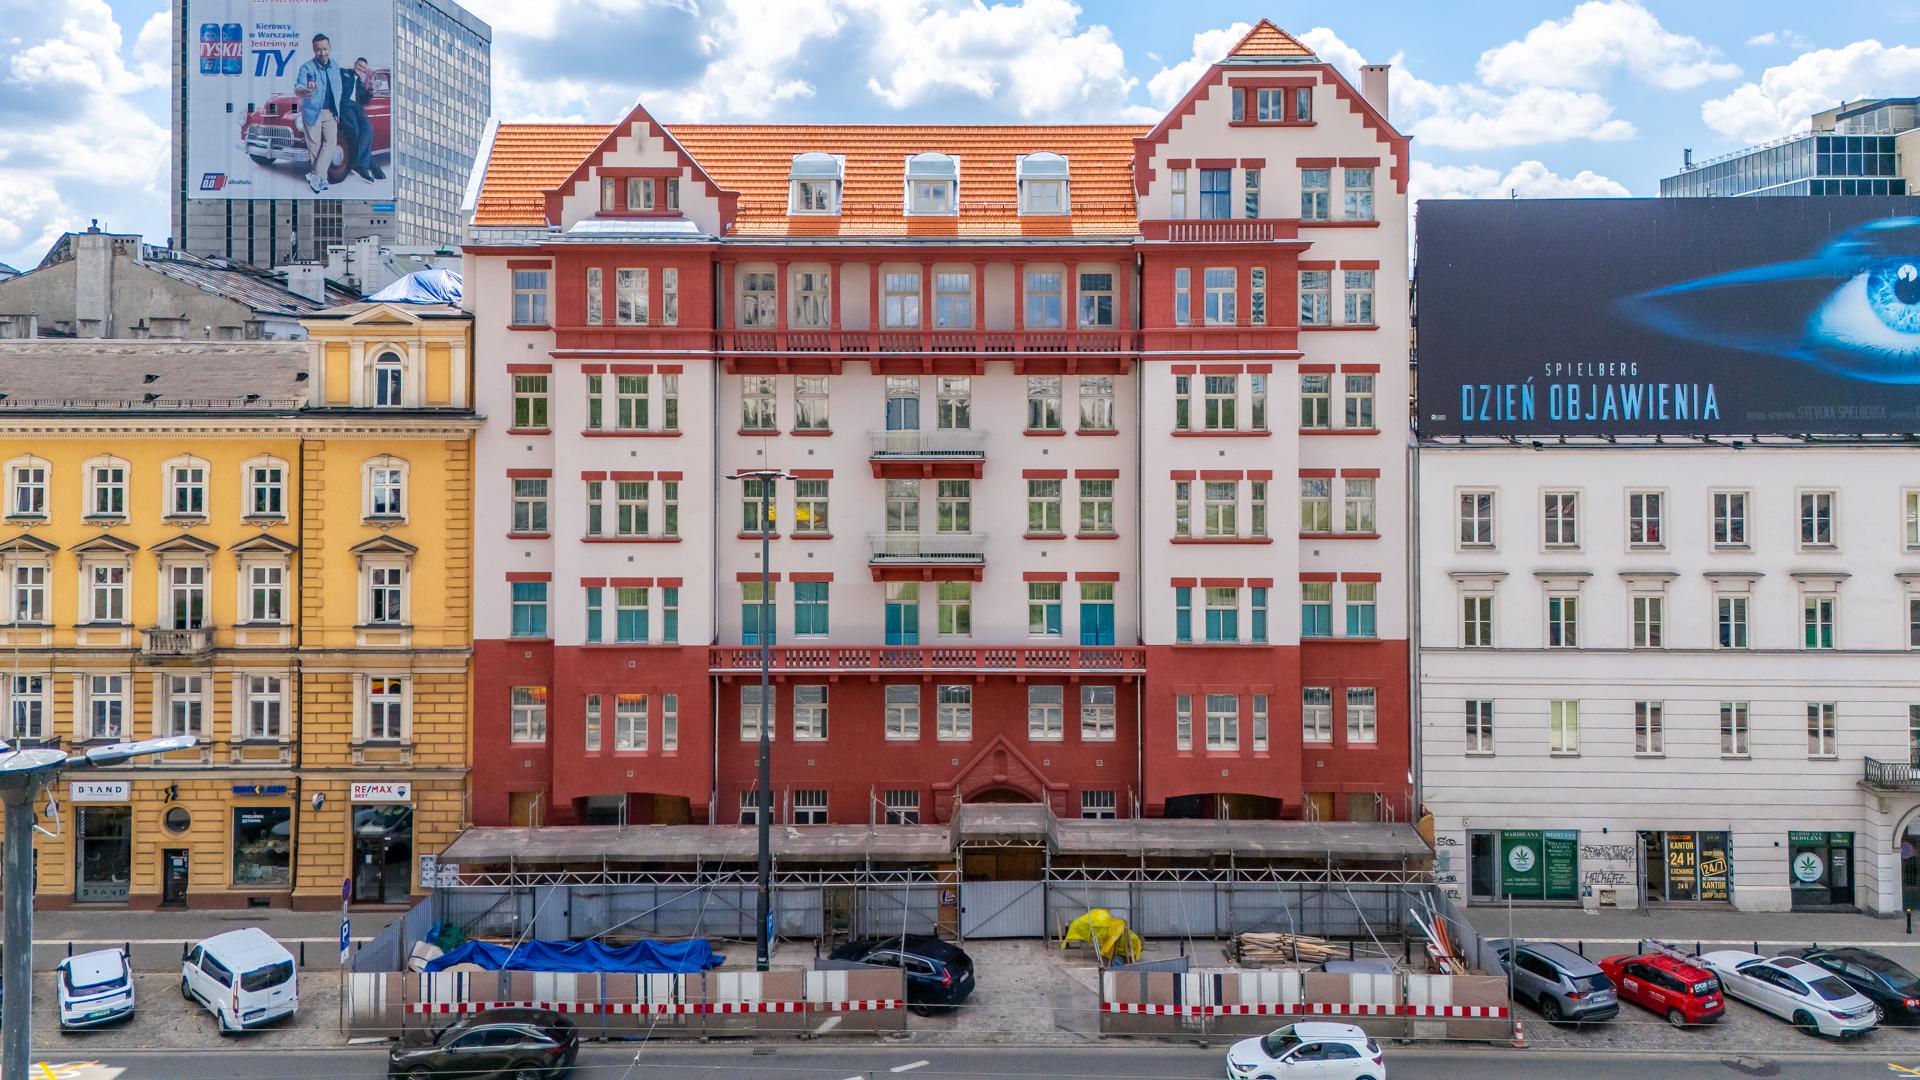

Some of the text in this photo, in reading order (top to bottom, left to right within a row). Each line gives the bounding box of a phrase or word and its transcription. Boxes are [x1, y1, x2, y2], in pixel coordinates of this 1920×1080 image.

[258, 31, 300, 39] Warszawie
[251, 49, 296, 77] TY
[1545, 362, 1638, 377] SPIELBERG
[1461, 376, 1721, 421] DZIEŃ OBJAWIENIA
[354, 785, 393, 794] RE/MAX
[1669, 841, 1694, 850] KANTOR
[1670, 852, 1695, 866] 24 H
[1703, 860, 1724, 875] 24/7
[1702, 881, 1726, 889] KANTOR
